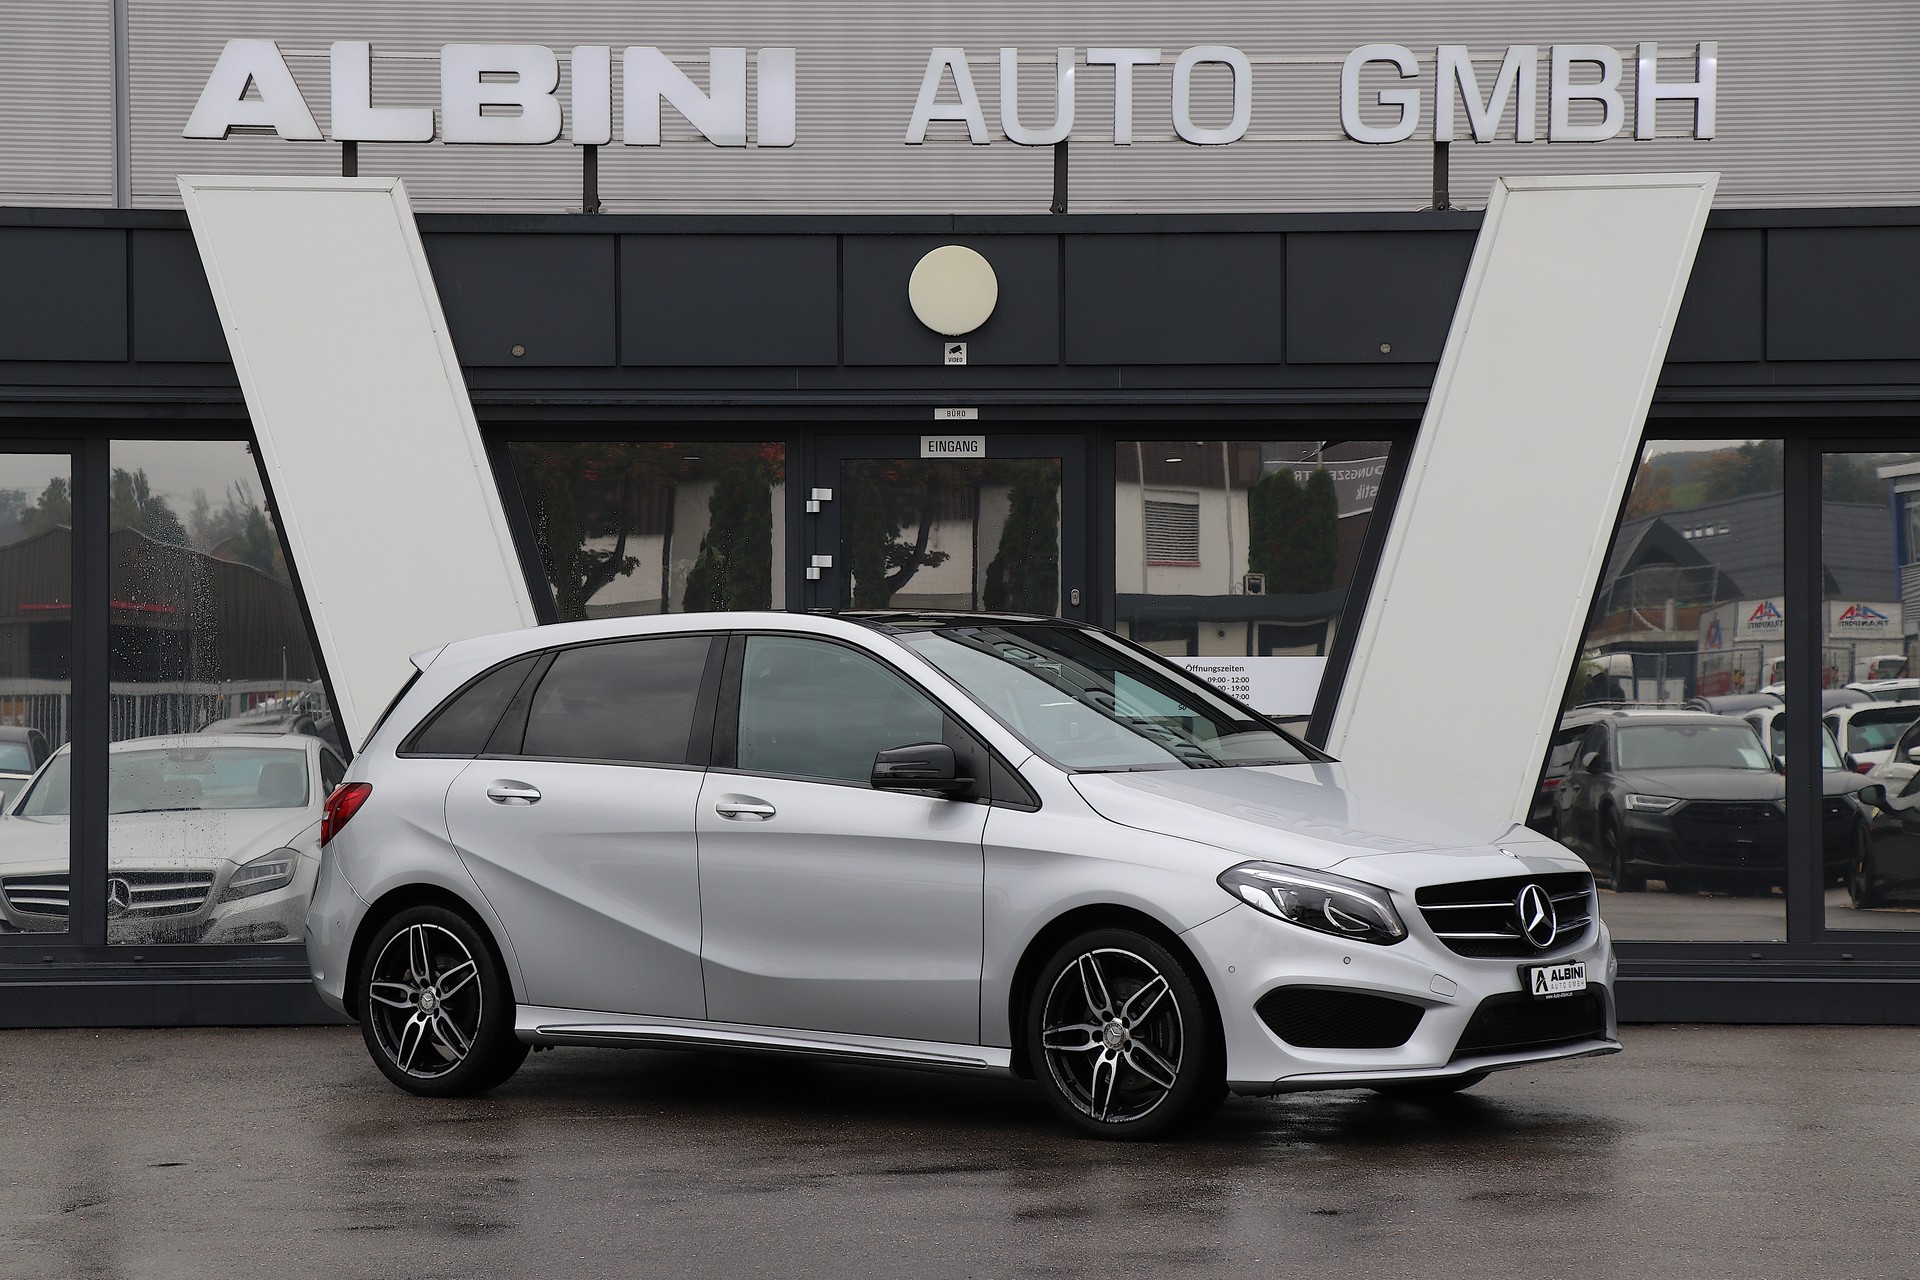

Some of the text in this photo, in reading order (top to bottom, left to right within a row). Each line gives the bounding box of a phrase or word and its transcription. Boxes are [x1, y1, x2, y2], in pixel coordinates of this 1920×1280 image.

[182, 38, 1718, 149] ALBINI AUTO GMBH
[946, 409, 966, 417] BÜRO
[928, 440, 978, 453] EINGANG
[1185, 663, 1245, 673] Öffnungszeiten
[1550, 966, 1584, 982] ALBINI
